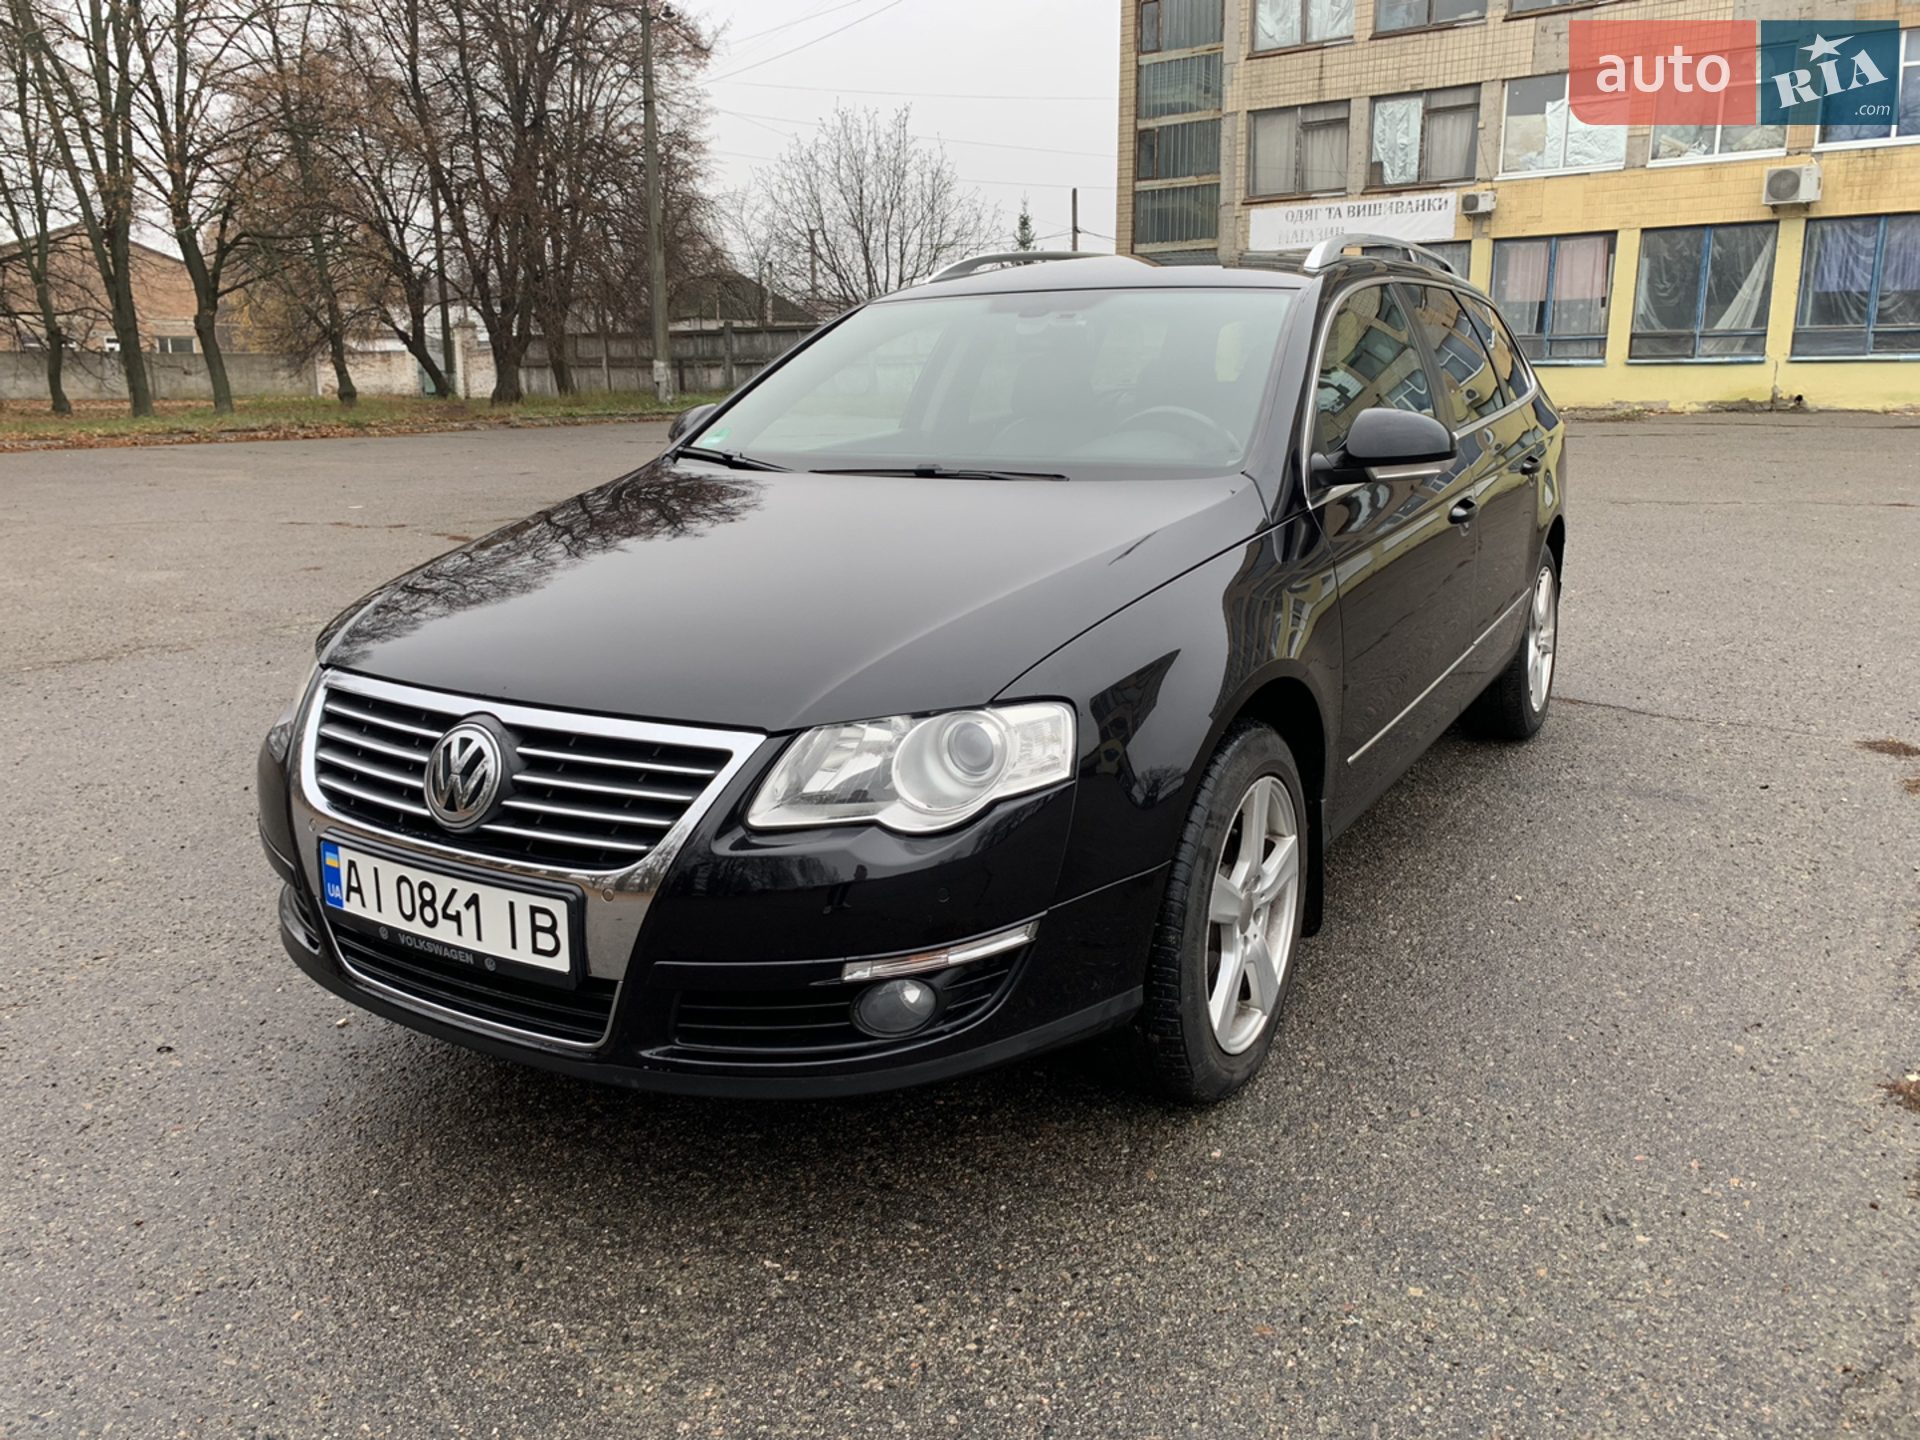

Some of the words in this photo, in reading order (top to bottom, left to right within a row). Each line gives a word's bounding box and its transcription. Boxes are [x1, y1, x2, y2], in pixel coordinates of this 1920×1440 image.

[1284, 208, 1322, 225] ОДЯГ
[1325, 206, 1342, 220] ТА
[1347, 197, 1449, 218] ВИШИВАНКИ
[327, 882, 342, 900] UA
[396, 874, 482, 942] 0841
[398, 932, 474, 965] VOLKSWAGEN
